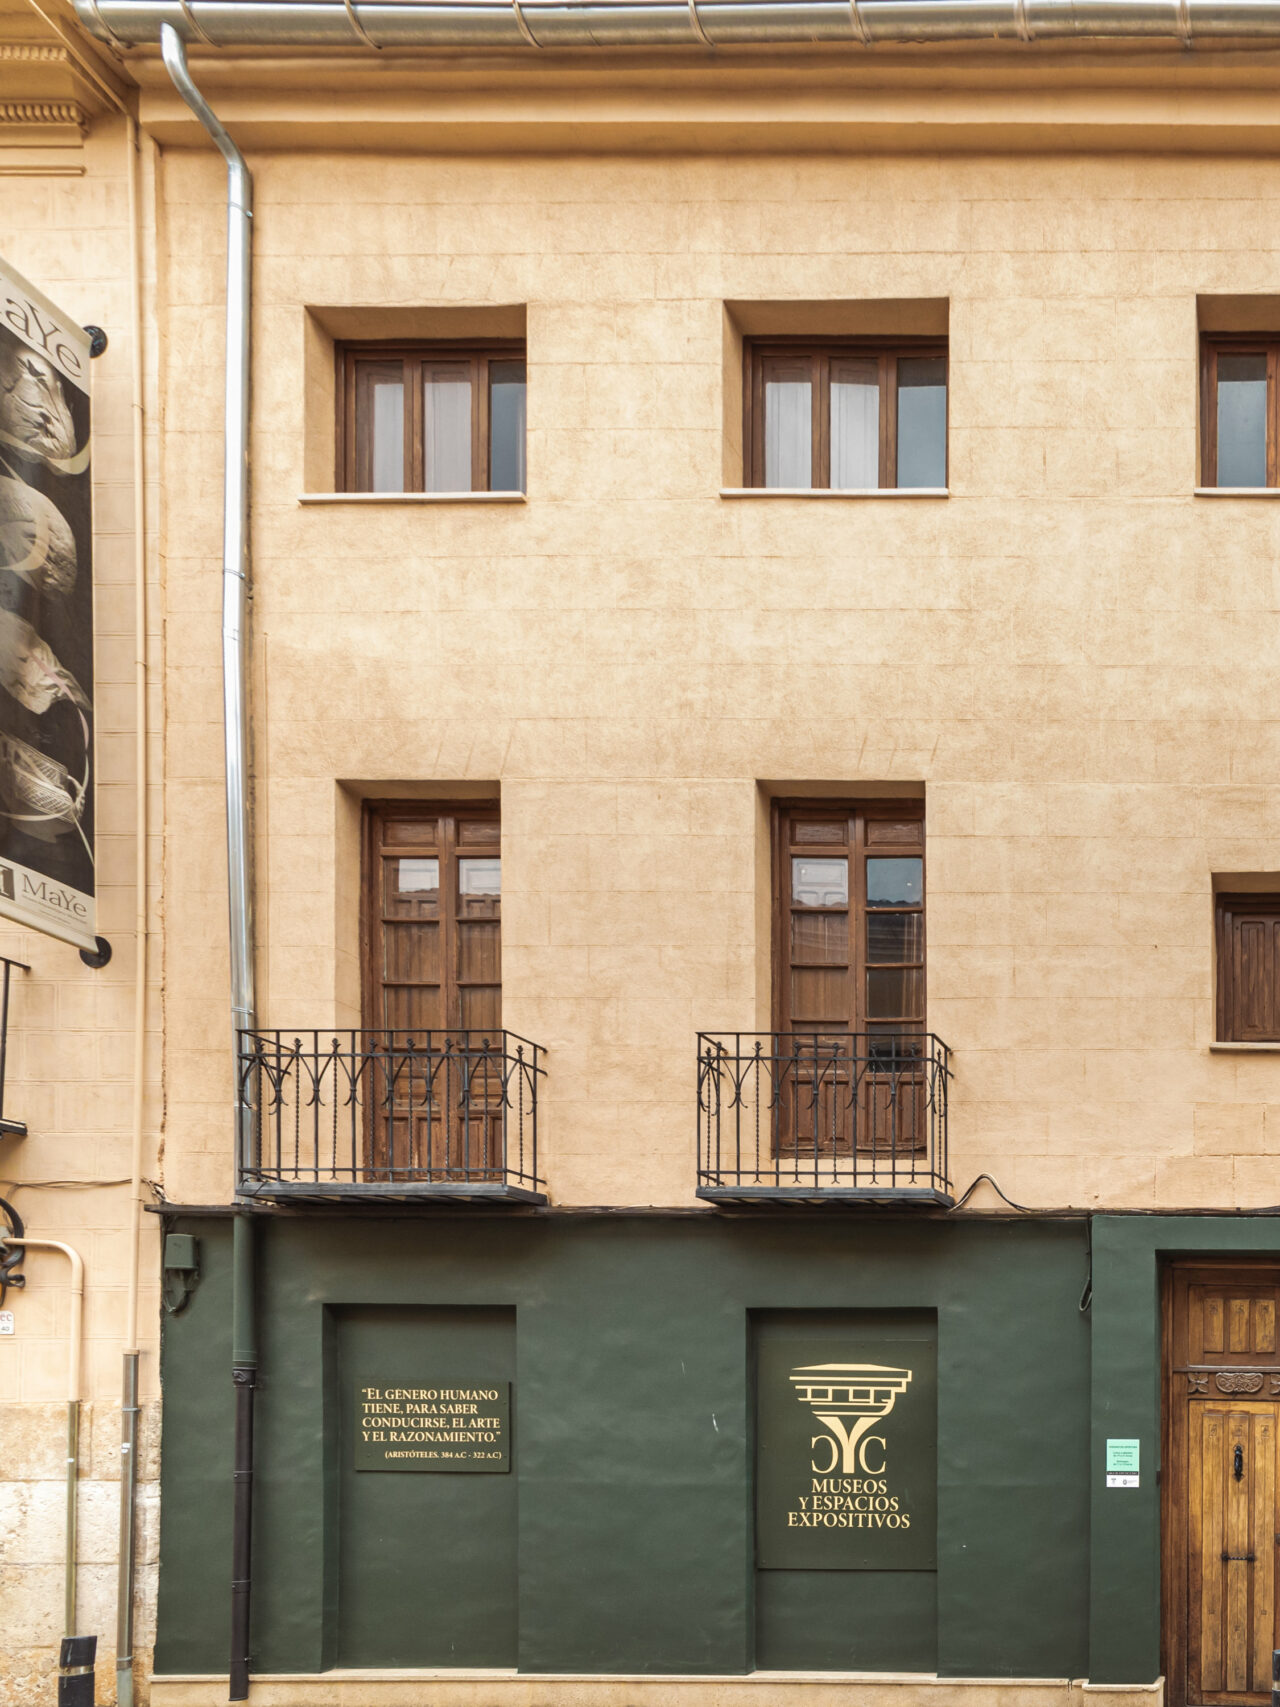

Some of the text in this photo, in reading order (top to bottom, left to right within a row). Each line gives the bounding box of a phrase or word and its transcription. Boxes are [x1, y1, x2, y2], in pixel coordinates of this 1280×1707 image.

[0, 298, 82, 378] aYe
[22, 873, 87, 918] MaYe
[440, 1389, 499, 1401] HUMANO
[361, 1403, 478, 1415] TIENE, PARA SABER
[361, 1417, 501, 1429] CONDUCIRSE, EL ARTE
[362, 1431, 371, 1442] Y
[372, 1431, 388, 1442] EL
[811, 1478, 888, 1494] MUSEOS
[798, 1495, 899, 1512] Y ESPACIOS
[787, 1511, 911, 1529] EXPOSITIVOS
